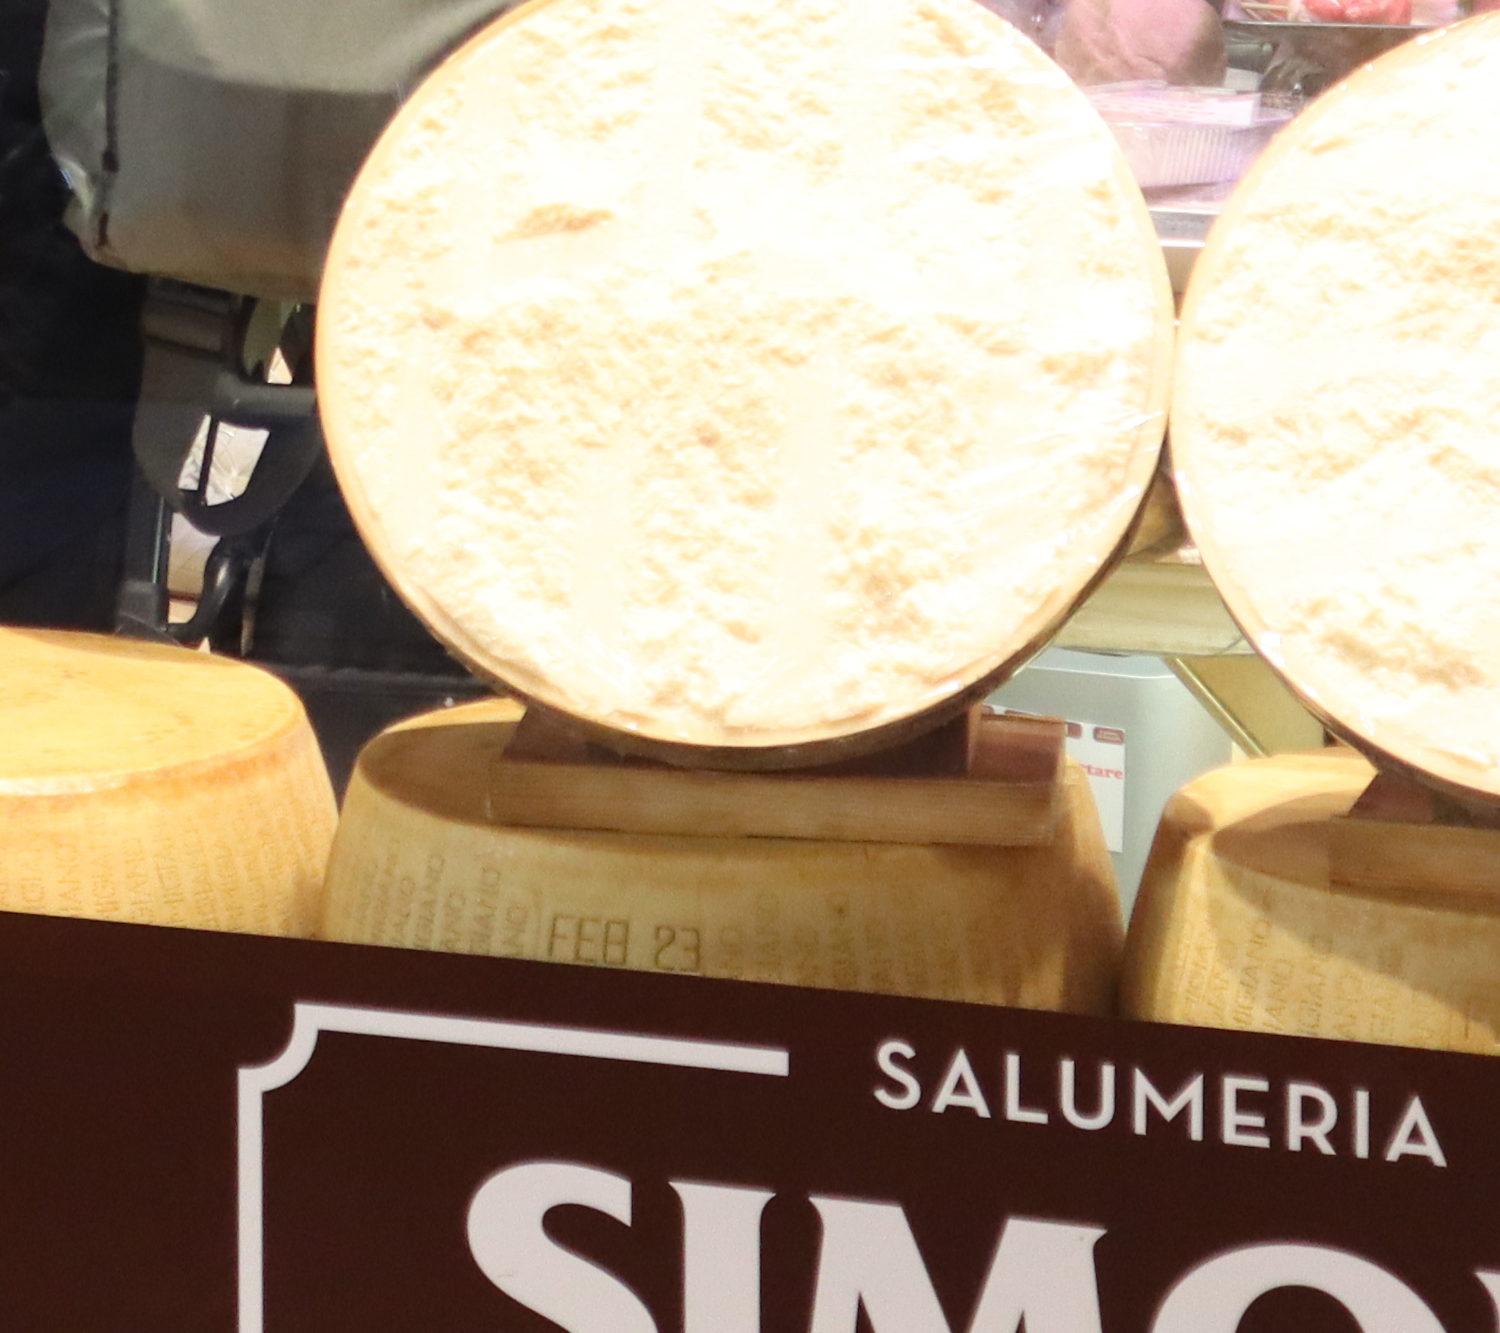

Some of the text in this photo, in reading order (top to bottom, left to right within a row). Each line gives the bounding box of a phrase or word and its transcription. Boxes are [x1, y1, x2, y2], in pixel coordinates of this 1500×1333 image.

[549, 913, 701, 974] FEB 23
[873, 1038, 1447, 1169] SALUMERIA
